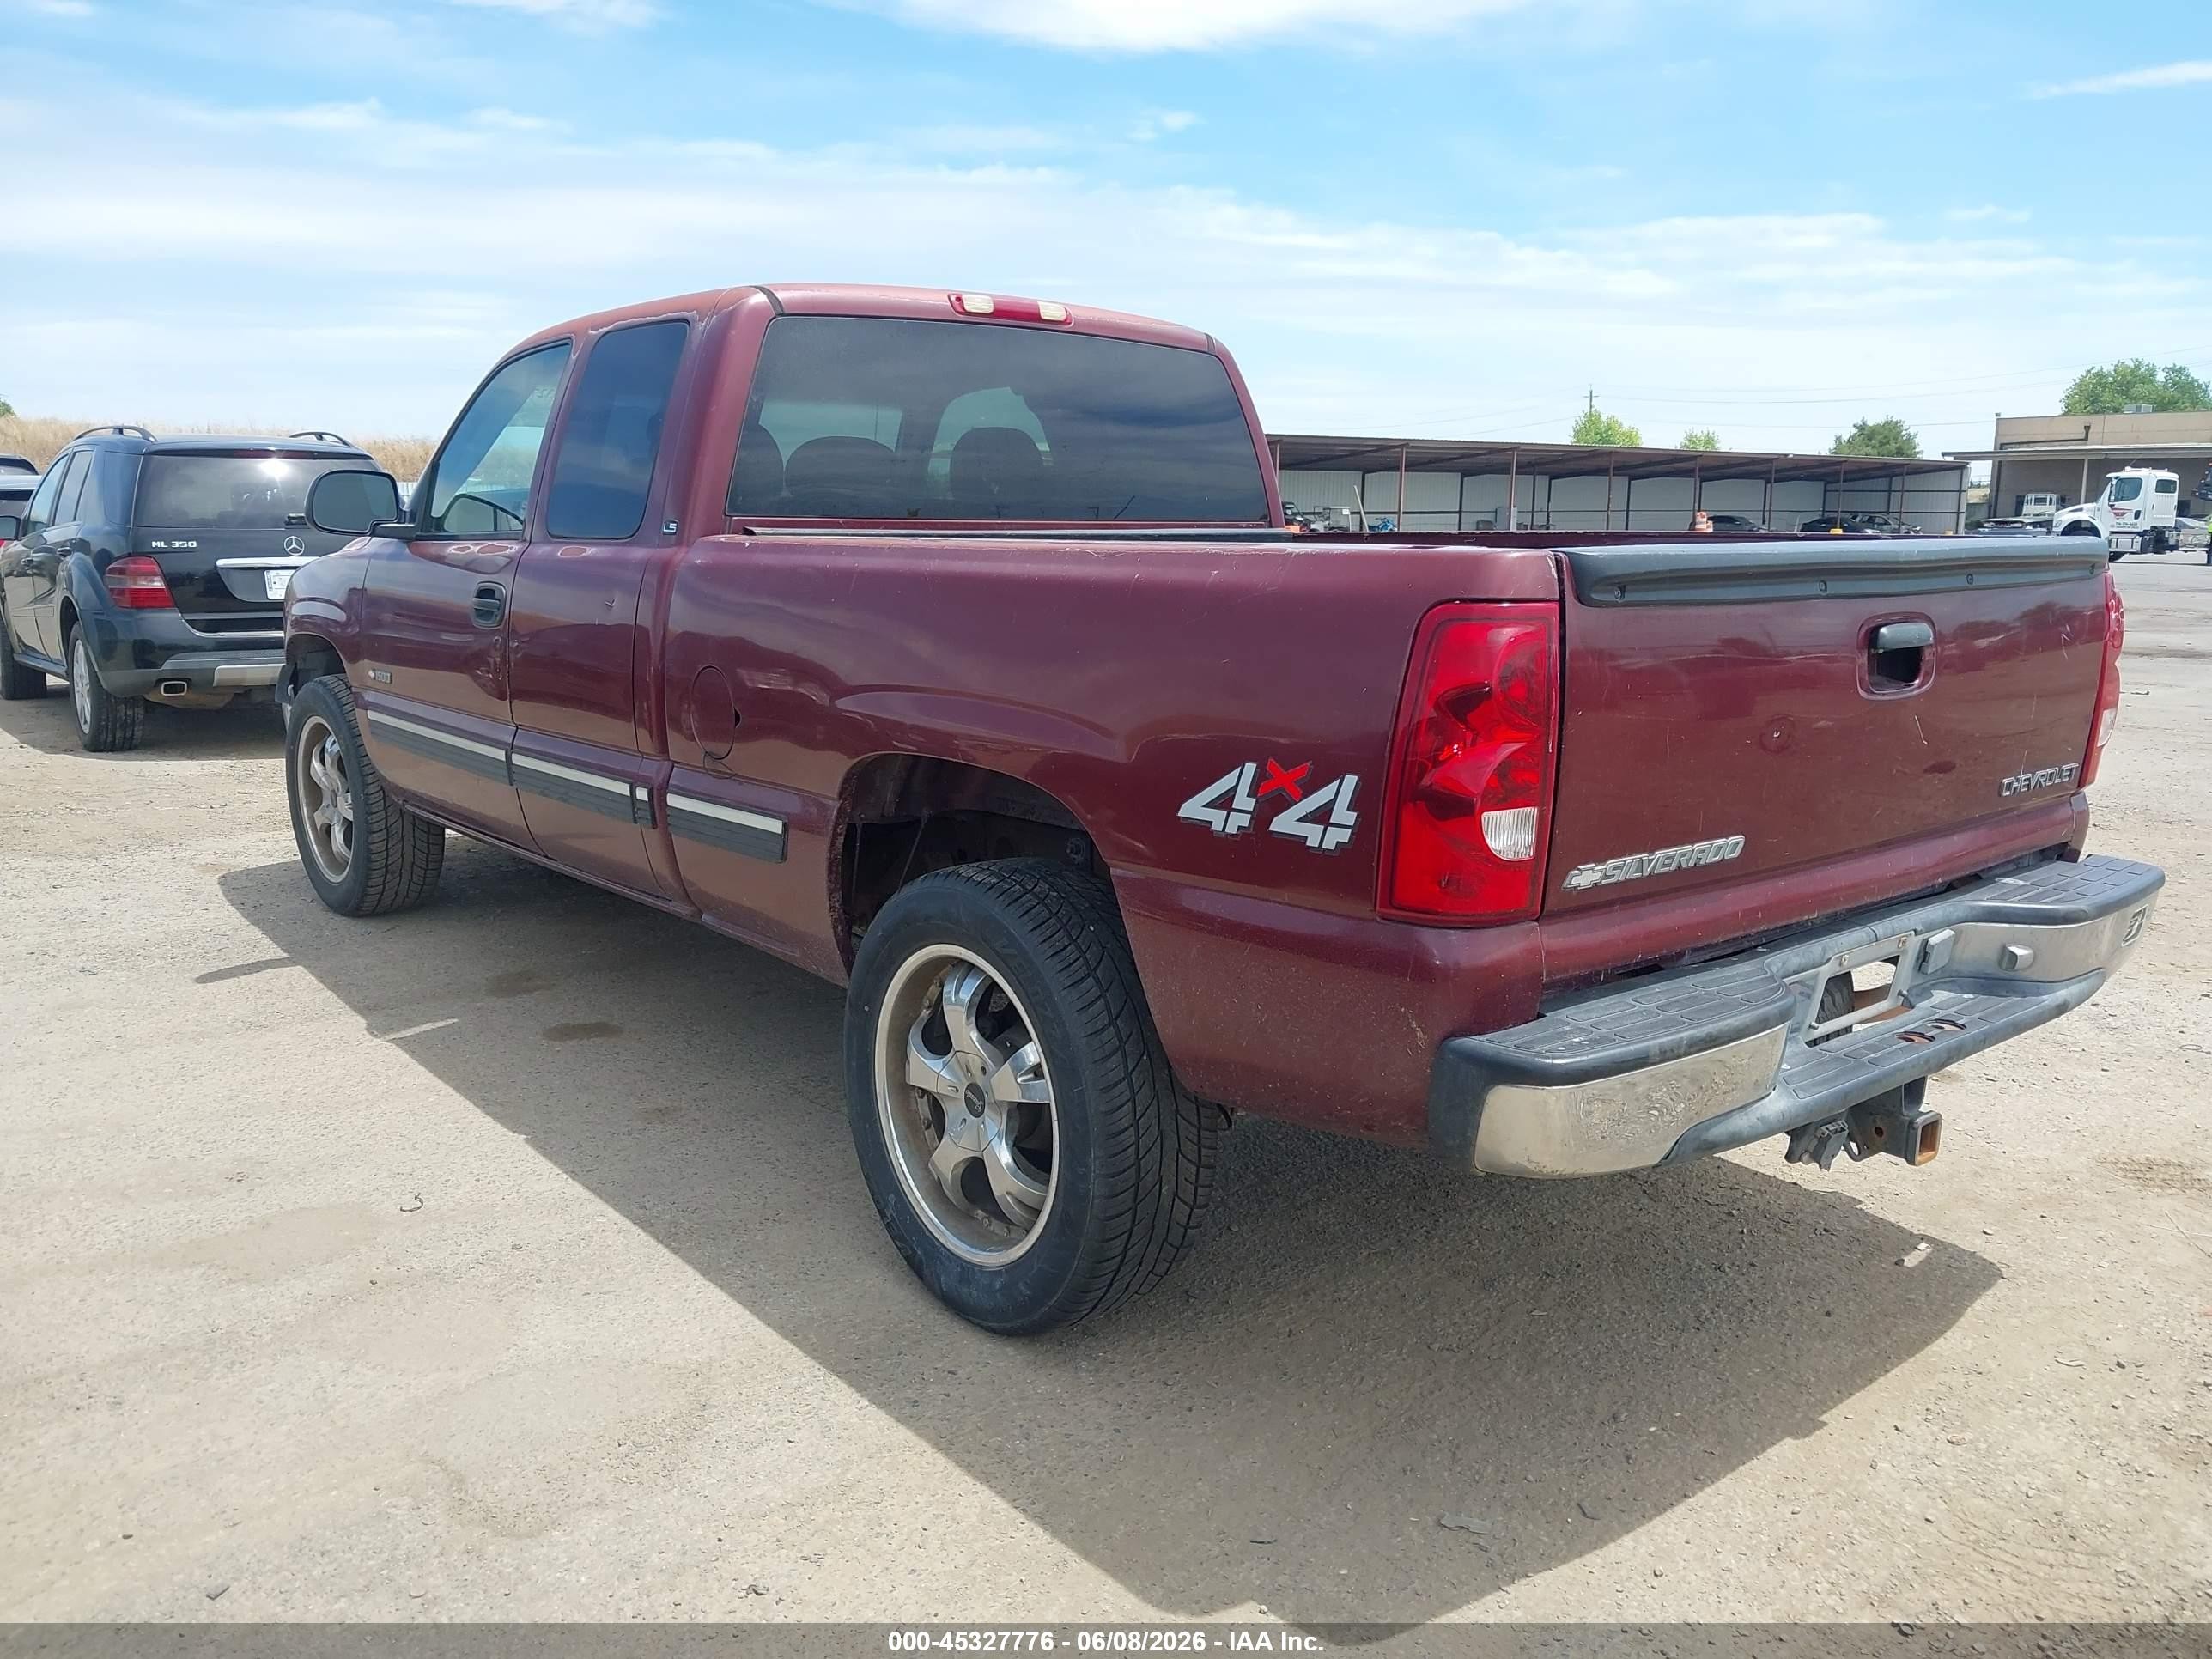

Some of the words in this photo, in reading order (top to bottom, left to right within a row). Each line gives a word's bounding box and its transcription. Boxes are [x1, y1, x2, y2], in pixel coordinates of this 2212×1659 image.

[663, 521, 678, 532] LS
[1998, 762, 2080, 797] CHEVROLET
[1601, 835, 1745, 884] SILVERADO
